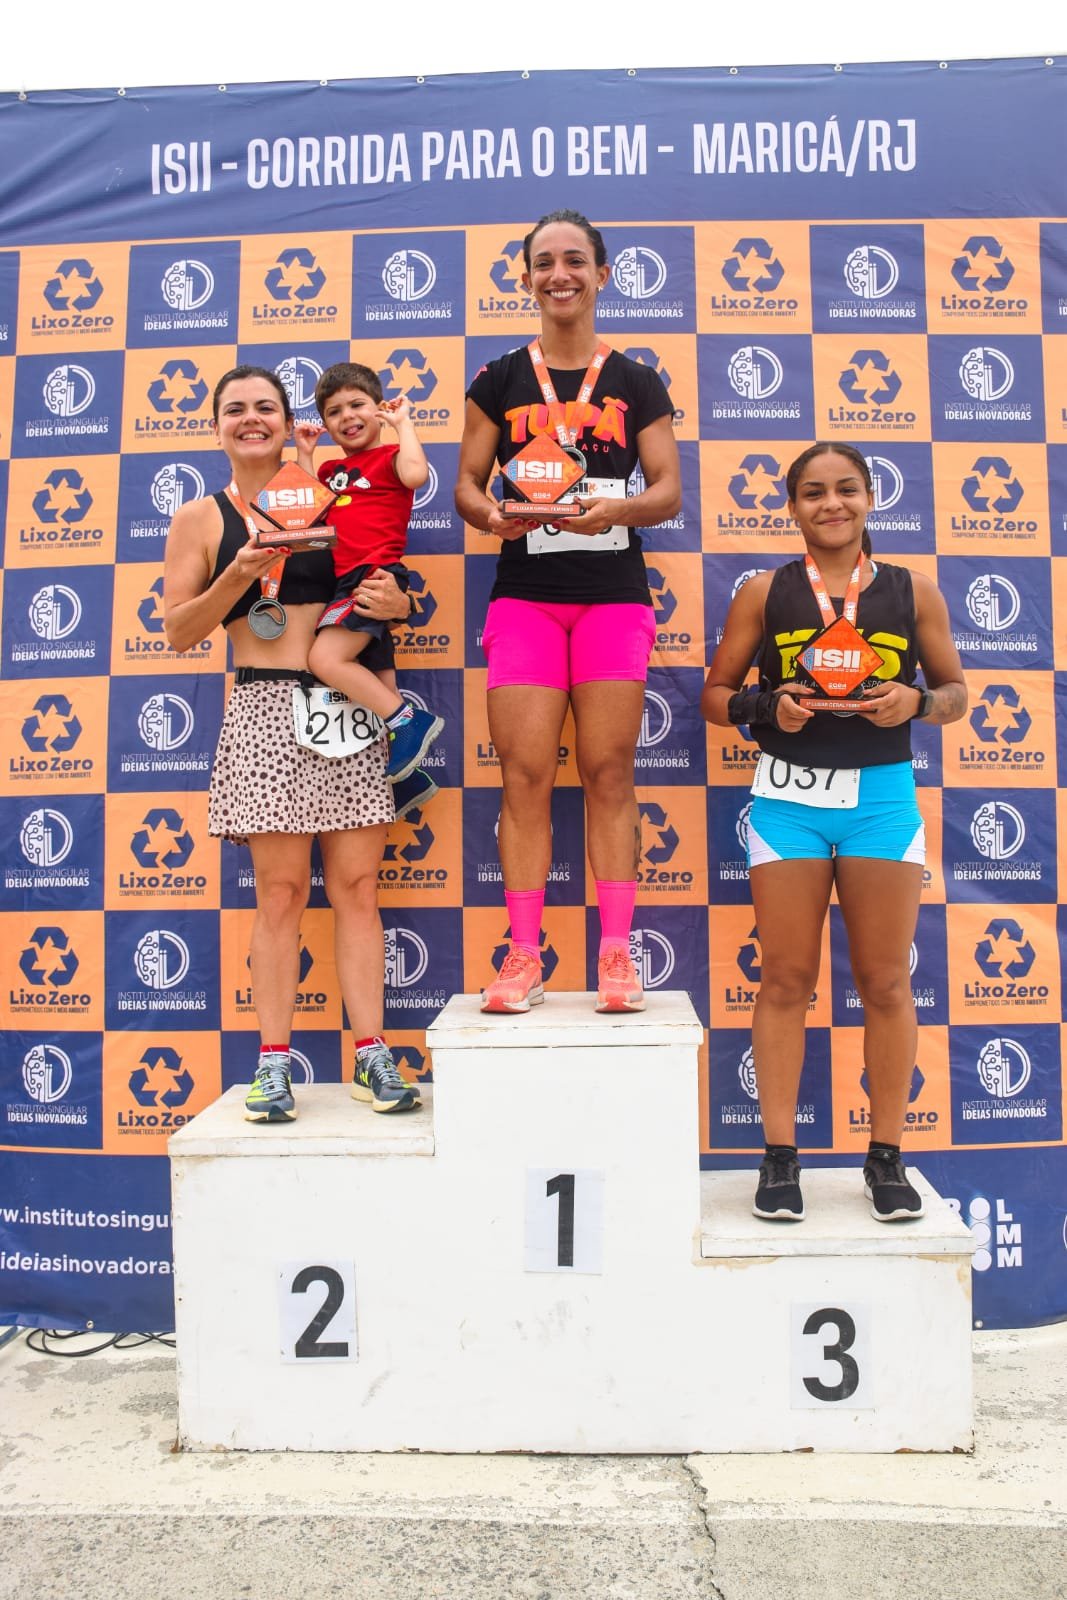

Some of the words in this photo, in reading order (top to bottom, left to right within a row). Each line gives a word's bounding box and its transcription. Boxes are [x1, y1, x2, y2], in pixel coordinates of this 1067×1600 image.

[152, 141, 211, 195] ISII
[247, 133, 412, 189] CORRIDA
[422, 128, 522, 181] PARA
[532, 126, 554, 177] O
[567, 125, 647, 176] BEM
[694, 115, 916, 176] MARICÁ/RJ
[366, 311, 394, 320] IDEIAS
[396, 310, 452, 320] INOVADORAS
[597, 309, 625, 318] IDEIAS
[627, 308, 683, 317] INOVADORAS
[829, 309, 857, 318] IDEIAS
[860, 309, 916, 318] INOVADORAS
[144, 321, 171, 330] IDEIAS
[174, 319, 228, 329] INOVADORAS
[713, 409, 741, 418] IDEIAS
[744, 409, 800, 418] INOVADORAS
[946, 411, 973, 420] IDEIAS
[976, 411, 1031, 420] INOVADORAS
[26, 427, 52, 437] IDEIAS
[54, 425, 109, 435] INOVADORAS
[518, 460, 562, 478] ISII
[131, 528, 158, 537] IDEIAS
[956, 642, 980, 650] DEIAS
[982, 642, 1037, 651] INOVADORAS
[12, 649, 39, 661] IDEIAS
[41, 648, 95, 660] INOVADORAS
[814, 648, 860, 667] ISII
[311, 708, 372, 744] 218
[122, 762, 149, 772] IDEIAS
[152, 761, 209, 771] INOVADORAS
[634, 758, 690, 768] NOVADORAS
[478, 872, 503, 881] IDEIA
[954, 870, 982, 880] IDEIAS
[984, 870, 1041, 880] INOVADORAS
[5, 878, 32, 888] IDEIAS
[34, 877, 89, 887] INOVADORAS
[118, 1001, 147, 1010] IDEIAS
[149, 1000, 206, 1010] INOVADORAS
[386, 999, 446, 1008] INOVADORAS
[8, 1113, 33, 1123] IDEIAS
[35, 1113, 87, 1125] INOVADORAS
[722, 1114, 752, 1124] IDEIAS
[963, 1109, 990, 1120] IDEIAS
[993, 1108, 1047, 1119] INOVADORAS
[546, 1174, 575, 1267] 1
[291, 1265, 349, 1358] 2
[802, 1308, 859, 1401] 3
